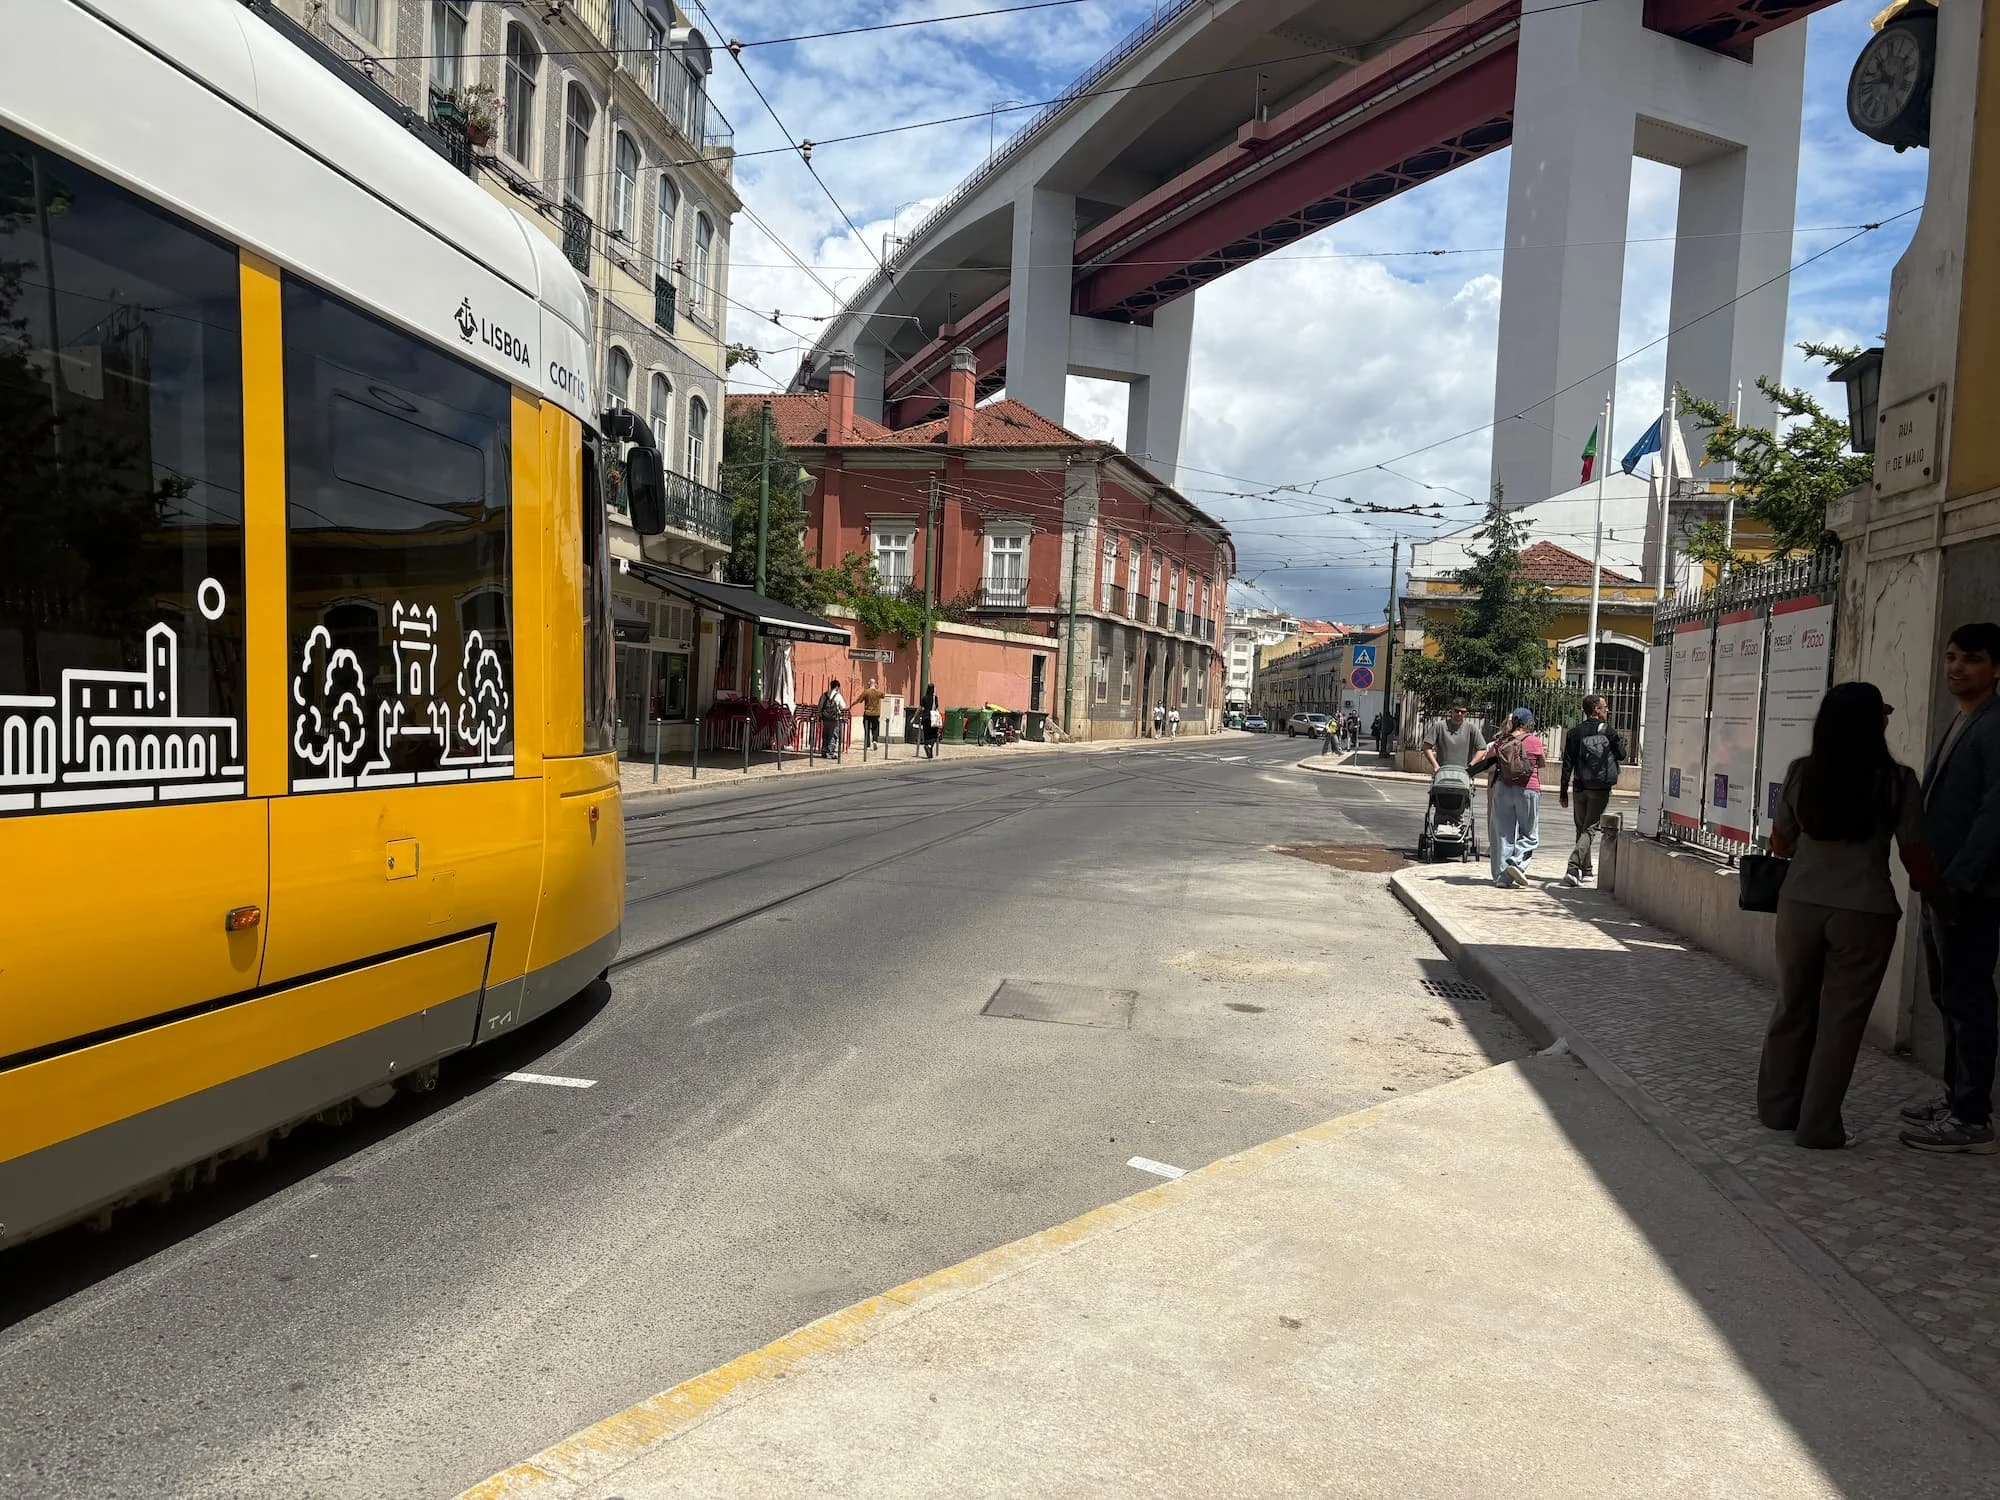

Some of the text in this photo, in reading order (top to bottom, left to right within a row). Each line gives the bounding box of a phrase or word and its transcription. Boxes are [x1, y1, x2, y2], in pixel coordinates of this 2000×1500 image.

[481, 318, 531, 369] LISBOA
[549, 361, 585, 404] carris
[1898, 421, 1912, 438] RUA
[1893, 455, 1903, 471] DE
[1905, 448, 1924, 466] MAIO
